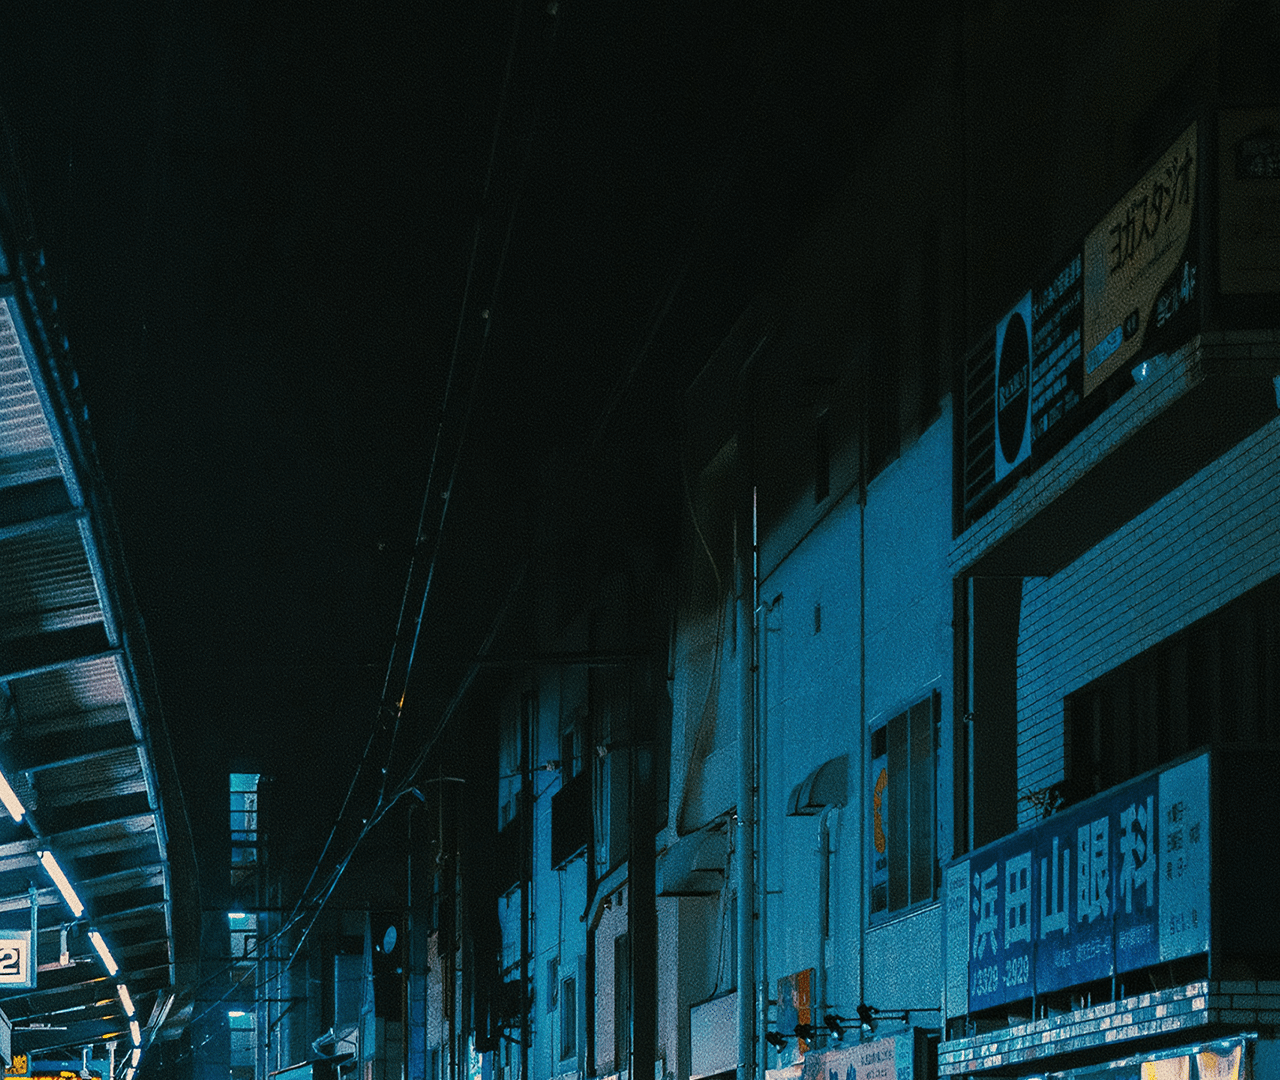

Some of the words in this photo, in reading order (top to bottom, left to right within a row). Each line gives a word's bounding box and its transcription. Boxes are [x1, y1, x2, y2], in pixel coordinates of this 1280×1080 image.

[1109, 147, 1194, 274] ヨガスタジオ
[971, 795, 1158, 961] 浜田山眼科
